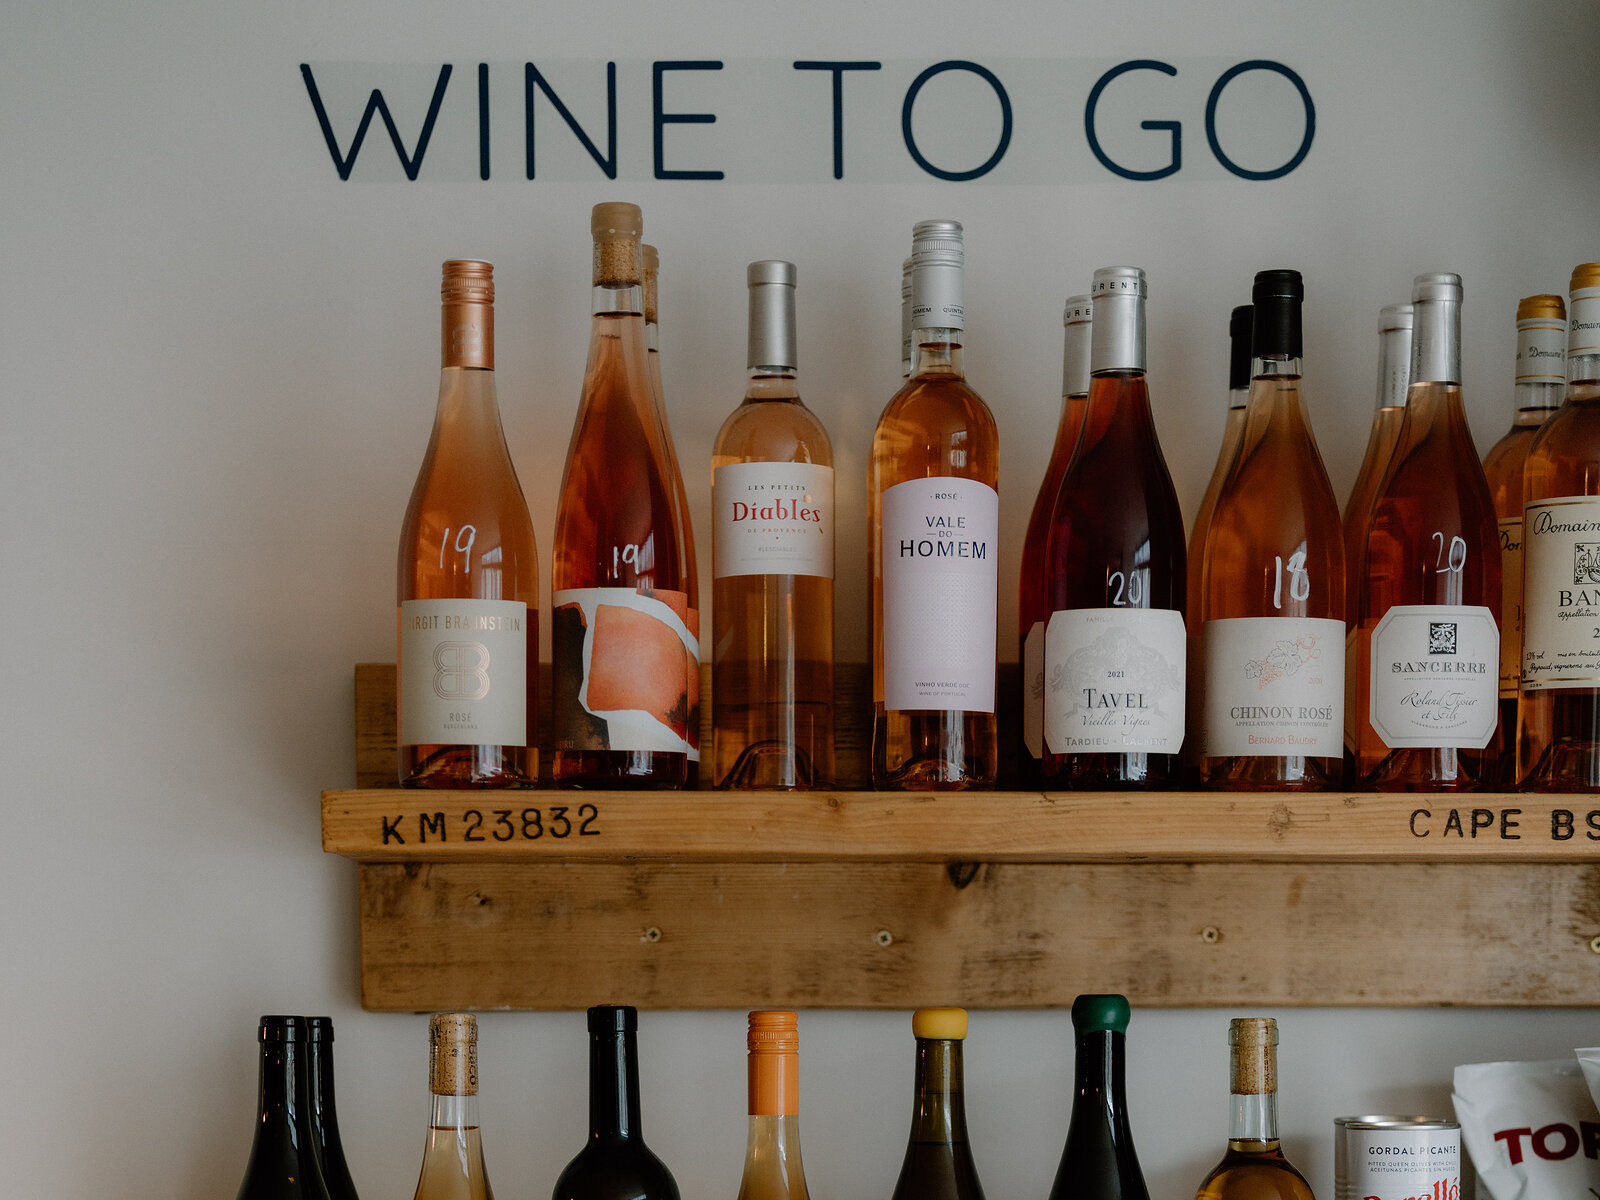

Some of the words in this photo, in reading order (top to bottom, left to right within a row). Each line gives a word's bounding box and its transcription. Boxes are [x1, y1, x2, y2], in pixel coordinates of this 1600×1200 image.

[300, 61, 724, 181] WINE
[793, 61, 1012, 182] TO
[1084, 60, 1316, 182] GO
[925, 516, 967, 529] VALE
[938, 530, 953, 538] DO
[440, 524, 476, 574] 19
[900, 540, 987, 559] HOMEM
[1432, 531, 1466, 573] 20
[613, 543, 640, 579] 19
[1108, 571, 1142, 606] 20
[1274, 551, 1310, 609] 18
[445, 615, 520, 631] BRAUNSTEIN
[1392, 662, 1486, 674] SANCERRE
[1400, 690, 1446, 708] Roland
[449, 711, 472, 722] ROSÉ
[1231, 706, 1293, 719] CHINON
[1299, 705, 1333, 720] ROSÉ
[463, 804, 600, 842] 23832
[1410, 808, 1522, 840] CAPE
[1368, 1146, 1415, 1155] GORDAL
[1420, 1145, 1456, 1155] PICANTE
